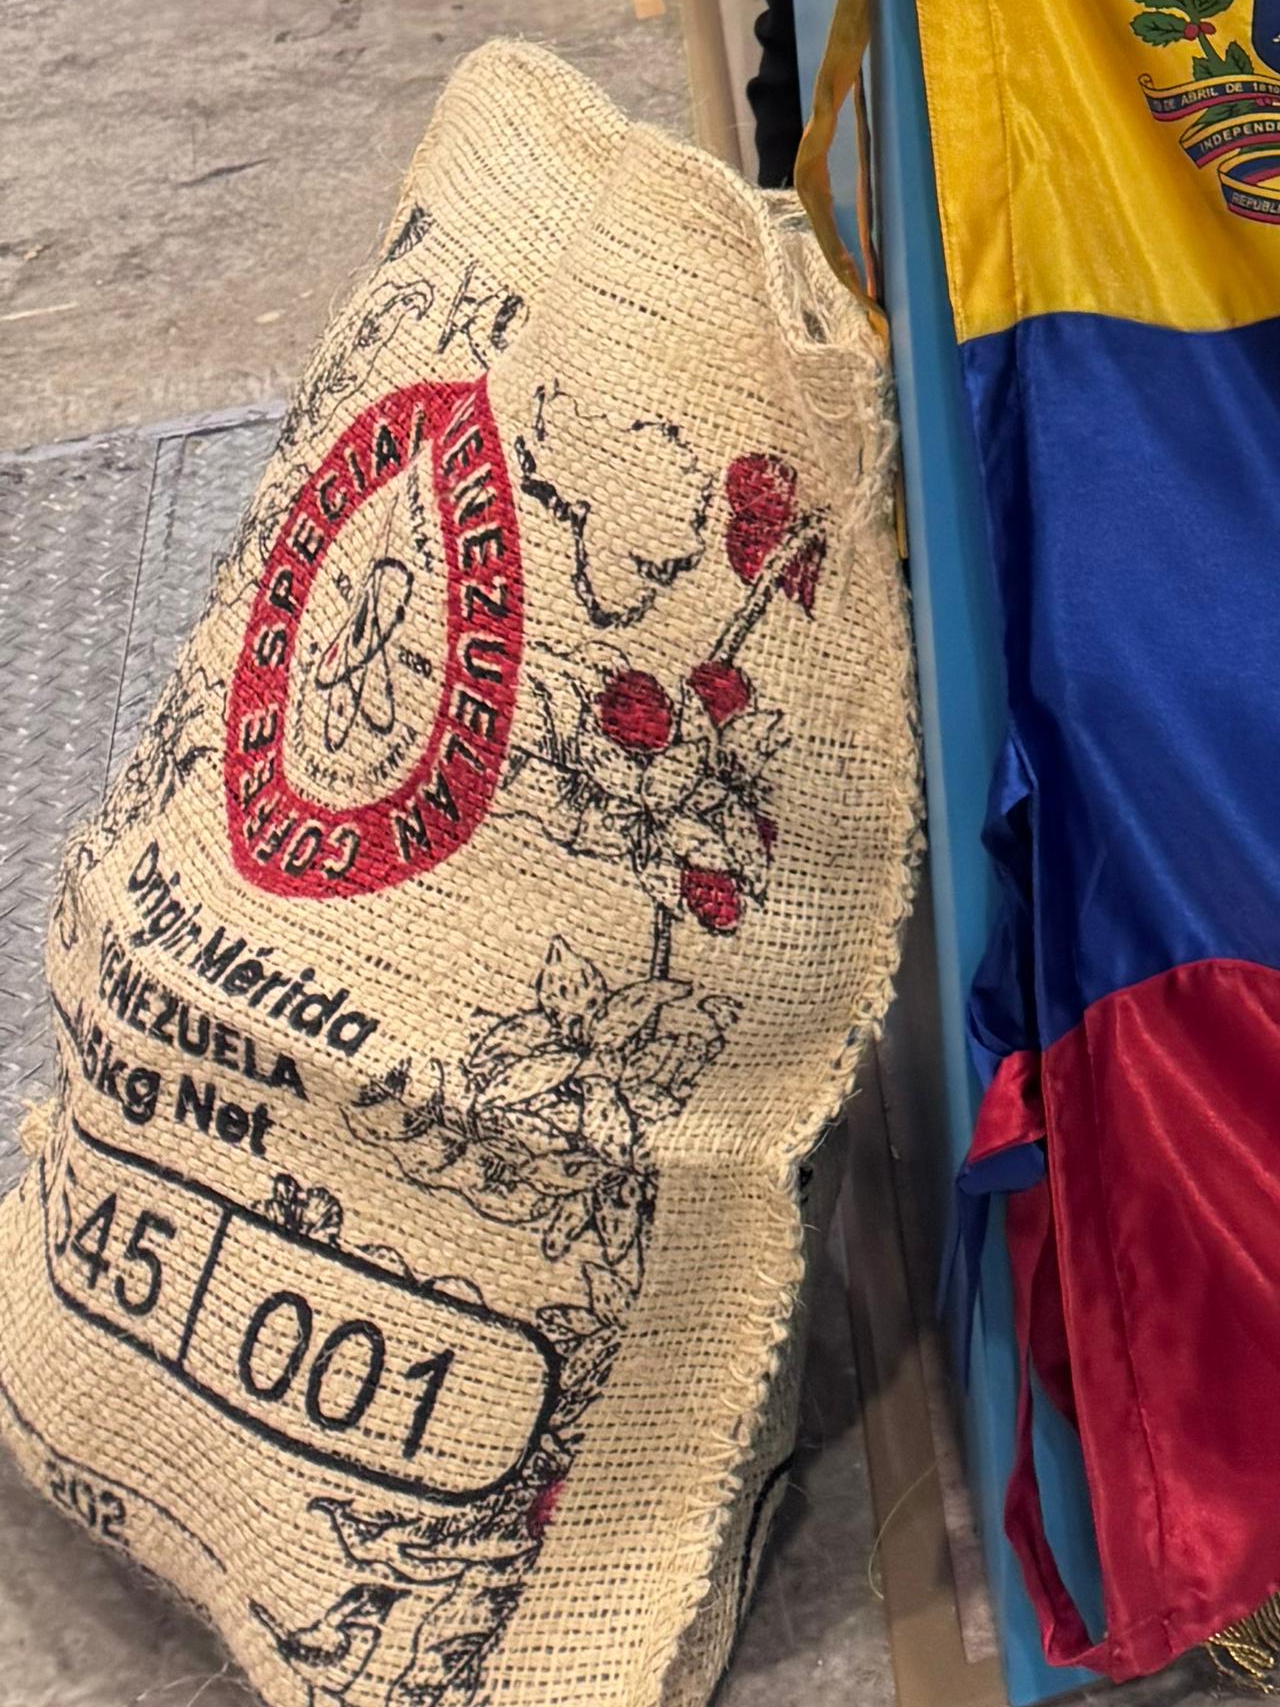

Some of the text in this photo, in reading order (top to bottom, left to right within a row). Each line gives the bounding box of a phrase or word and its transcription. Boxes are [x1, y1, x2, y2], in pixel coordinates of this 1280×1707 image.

[1225, 82, 1243, 95] DE
[198, 925, 381, 1057] Mérida
[175, 1076, 274, 1158] Net
[239, 1290, 456, 1460] 001
